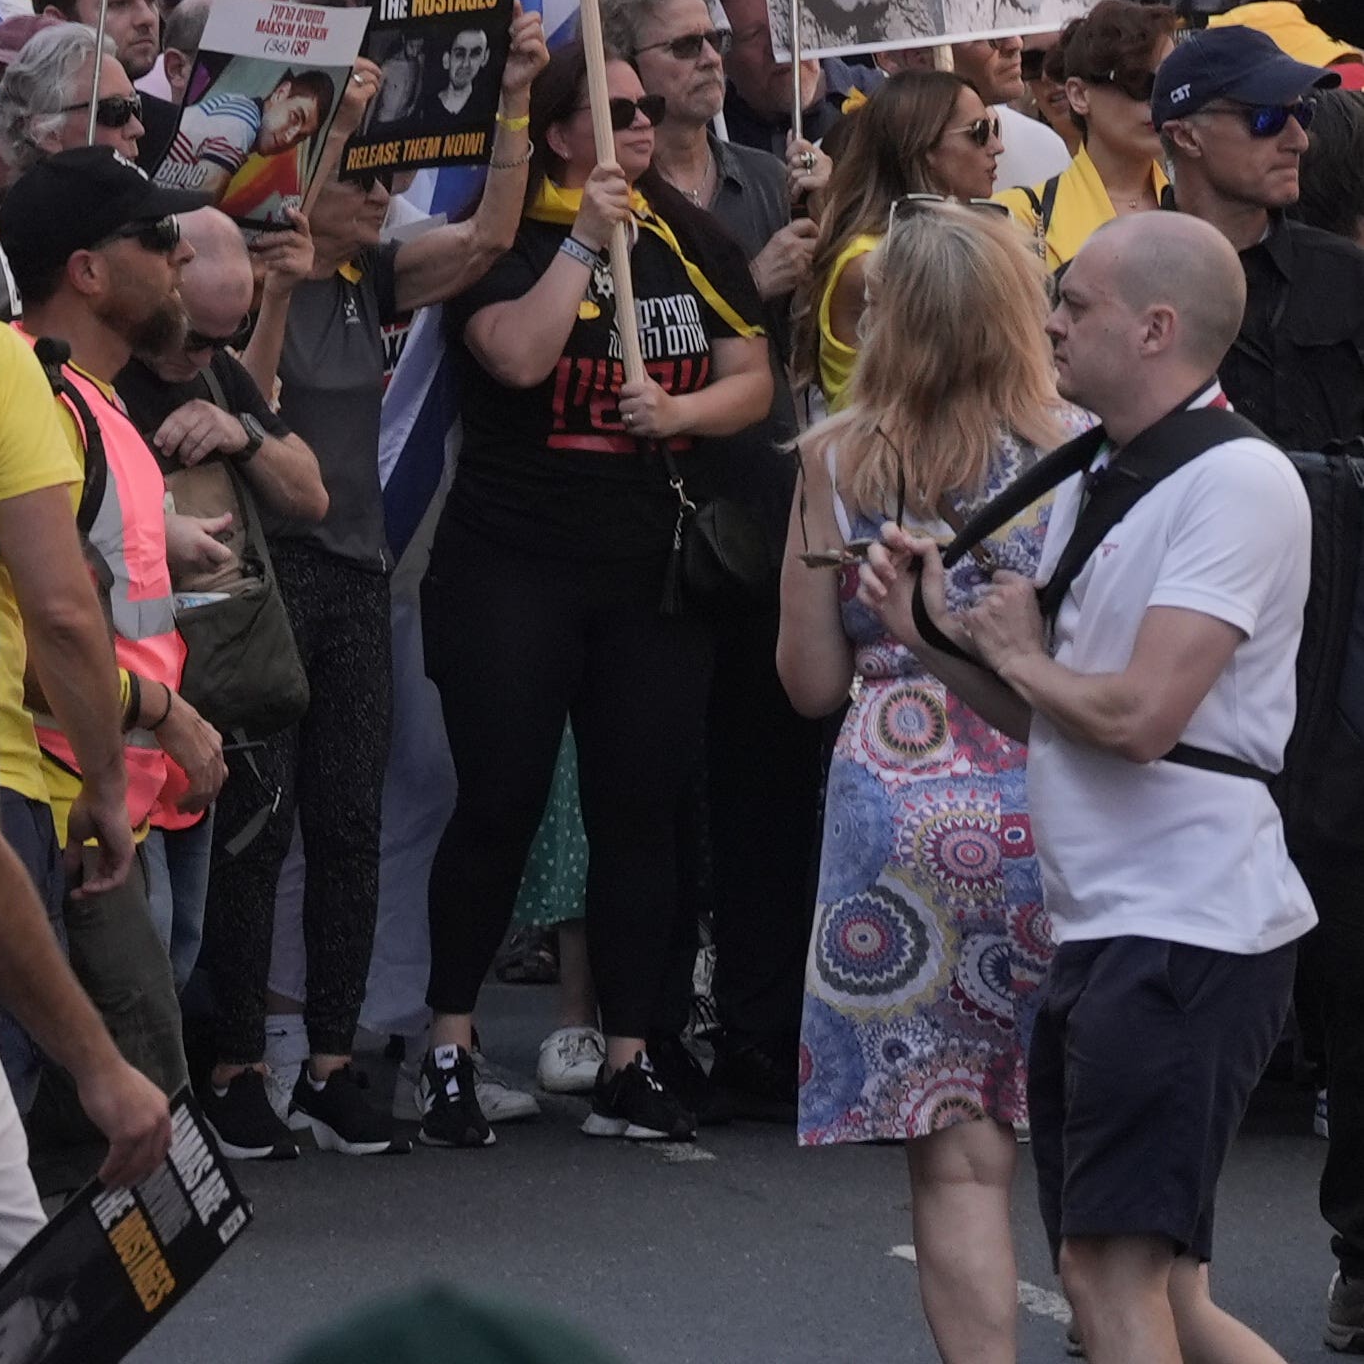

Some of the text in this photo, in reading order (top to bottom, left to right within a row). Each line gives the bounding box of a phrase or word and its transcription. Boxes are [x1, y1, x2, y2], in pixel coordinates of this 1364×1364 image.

[255, 18, 295, 37] MAKSYM
[346, 132, 487, 172] RELEASE THEM NOW!
[154, 159, 208, 187] BRING
